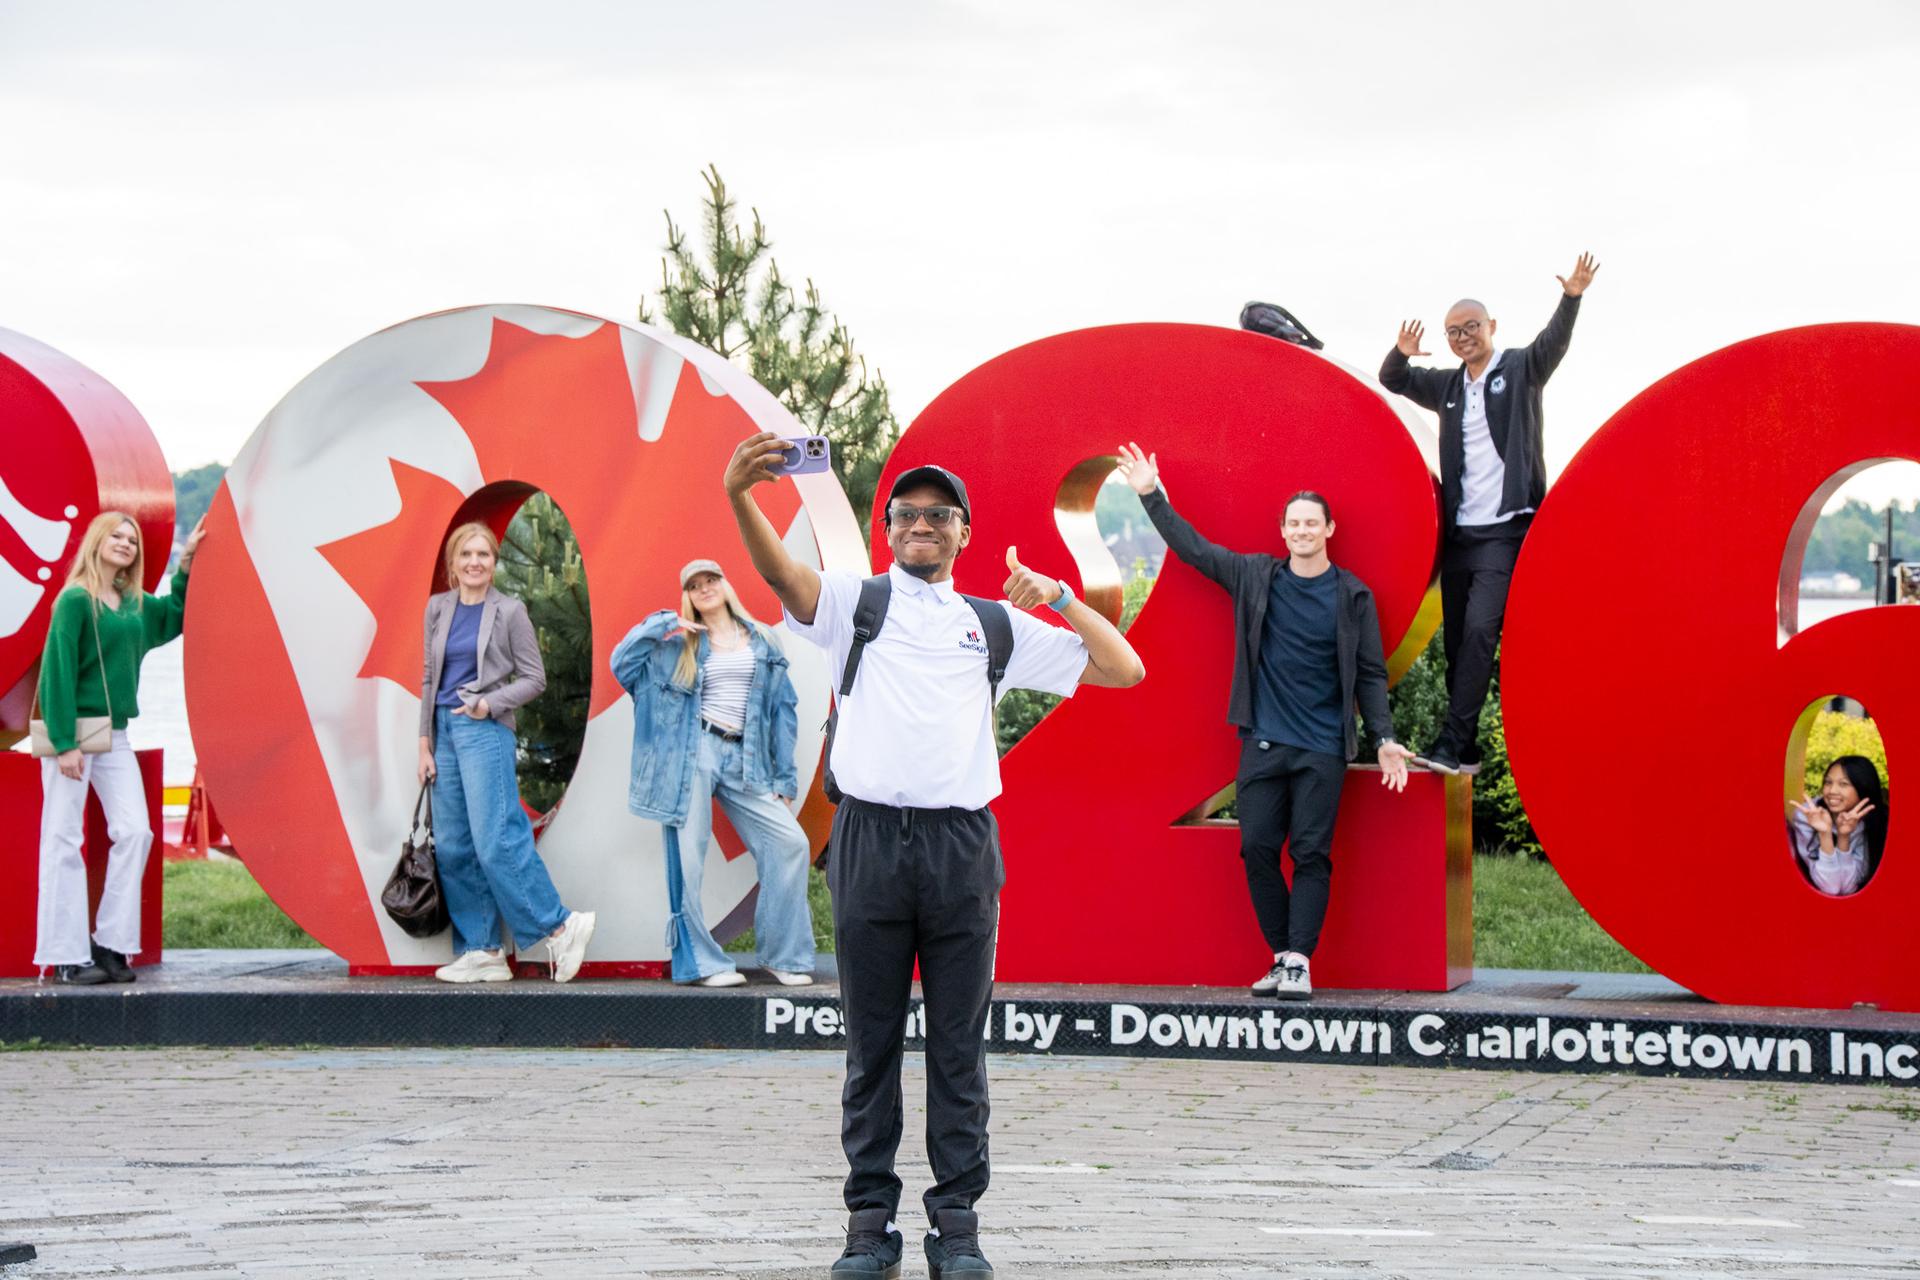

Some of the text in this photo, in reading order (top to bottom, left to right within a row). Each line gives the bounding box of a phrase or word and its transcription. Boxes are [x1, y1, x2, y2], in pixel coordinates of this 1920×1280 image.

[1005, 1003, 1061, 1050] by
[1111, 1004, 1391, 1055] Downtown
[1830, 1032, 1919, 1079] Inc
